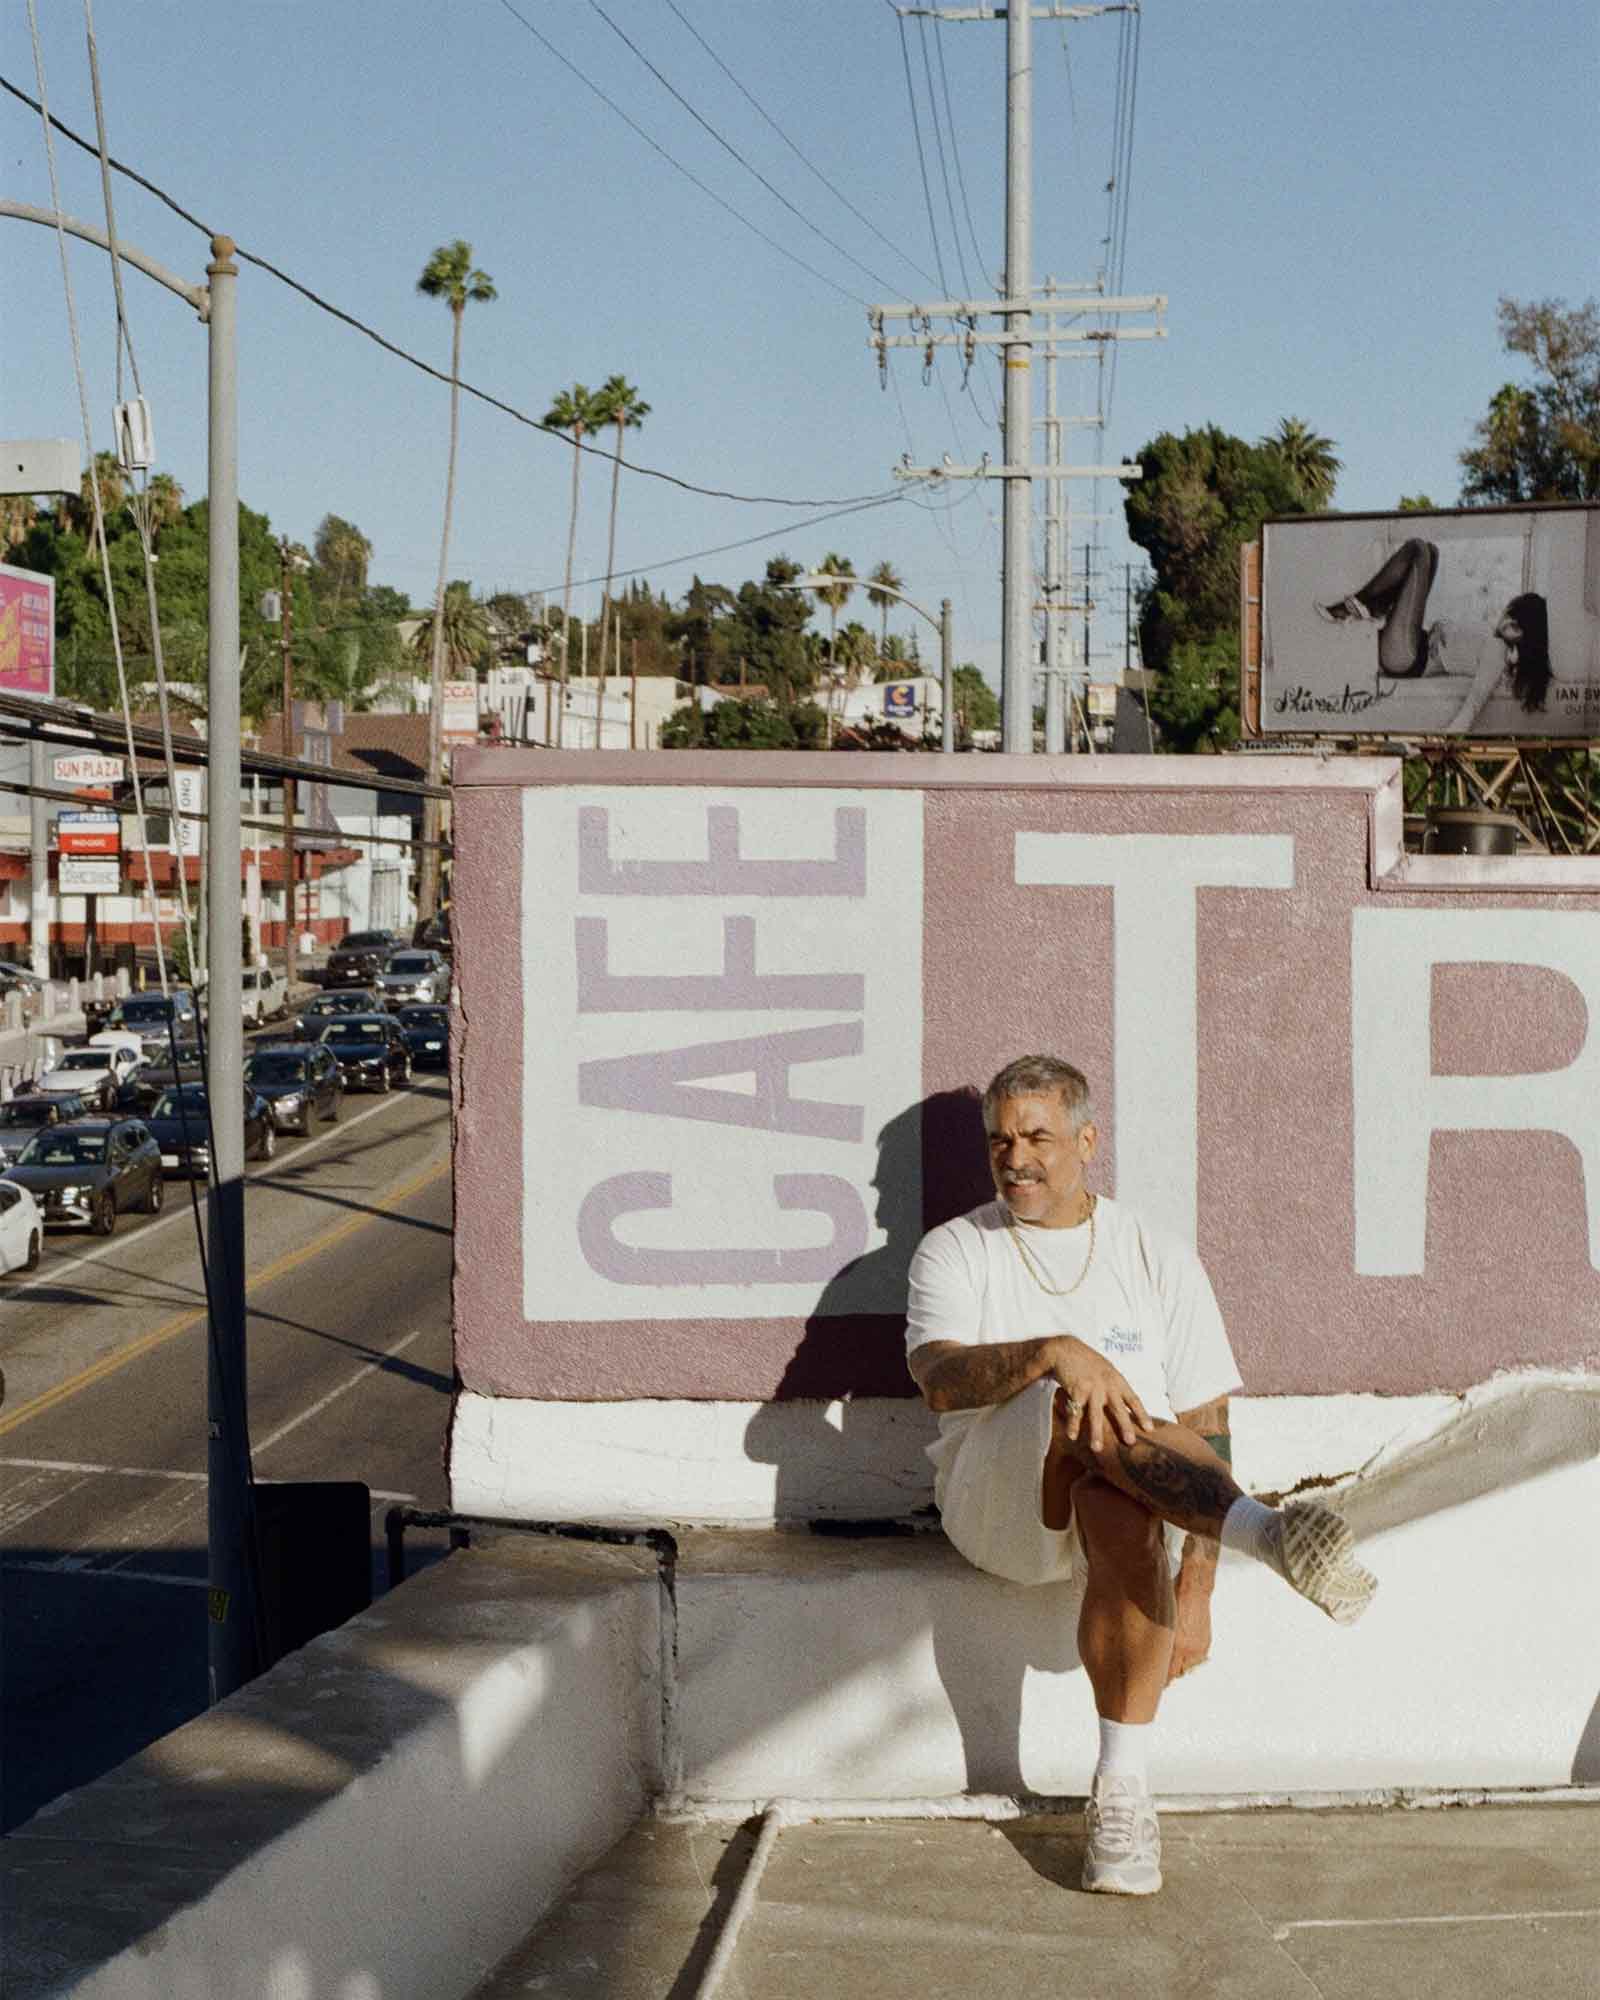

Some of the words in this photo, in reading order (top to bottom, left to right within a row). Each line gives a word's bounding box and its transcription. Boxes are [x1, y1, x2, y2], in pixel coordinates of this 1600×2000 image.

[56, 761, 80, 777] SUN
[83, 761, 120, 777] PLAZA
[575, 805, 869, 1288] CAFE
